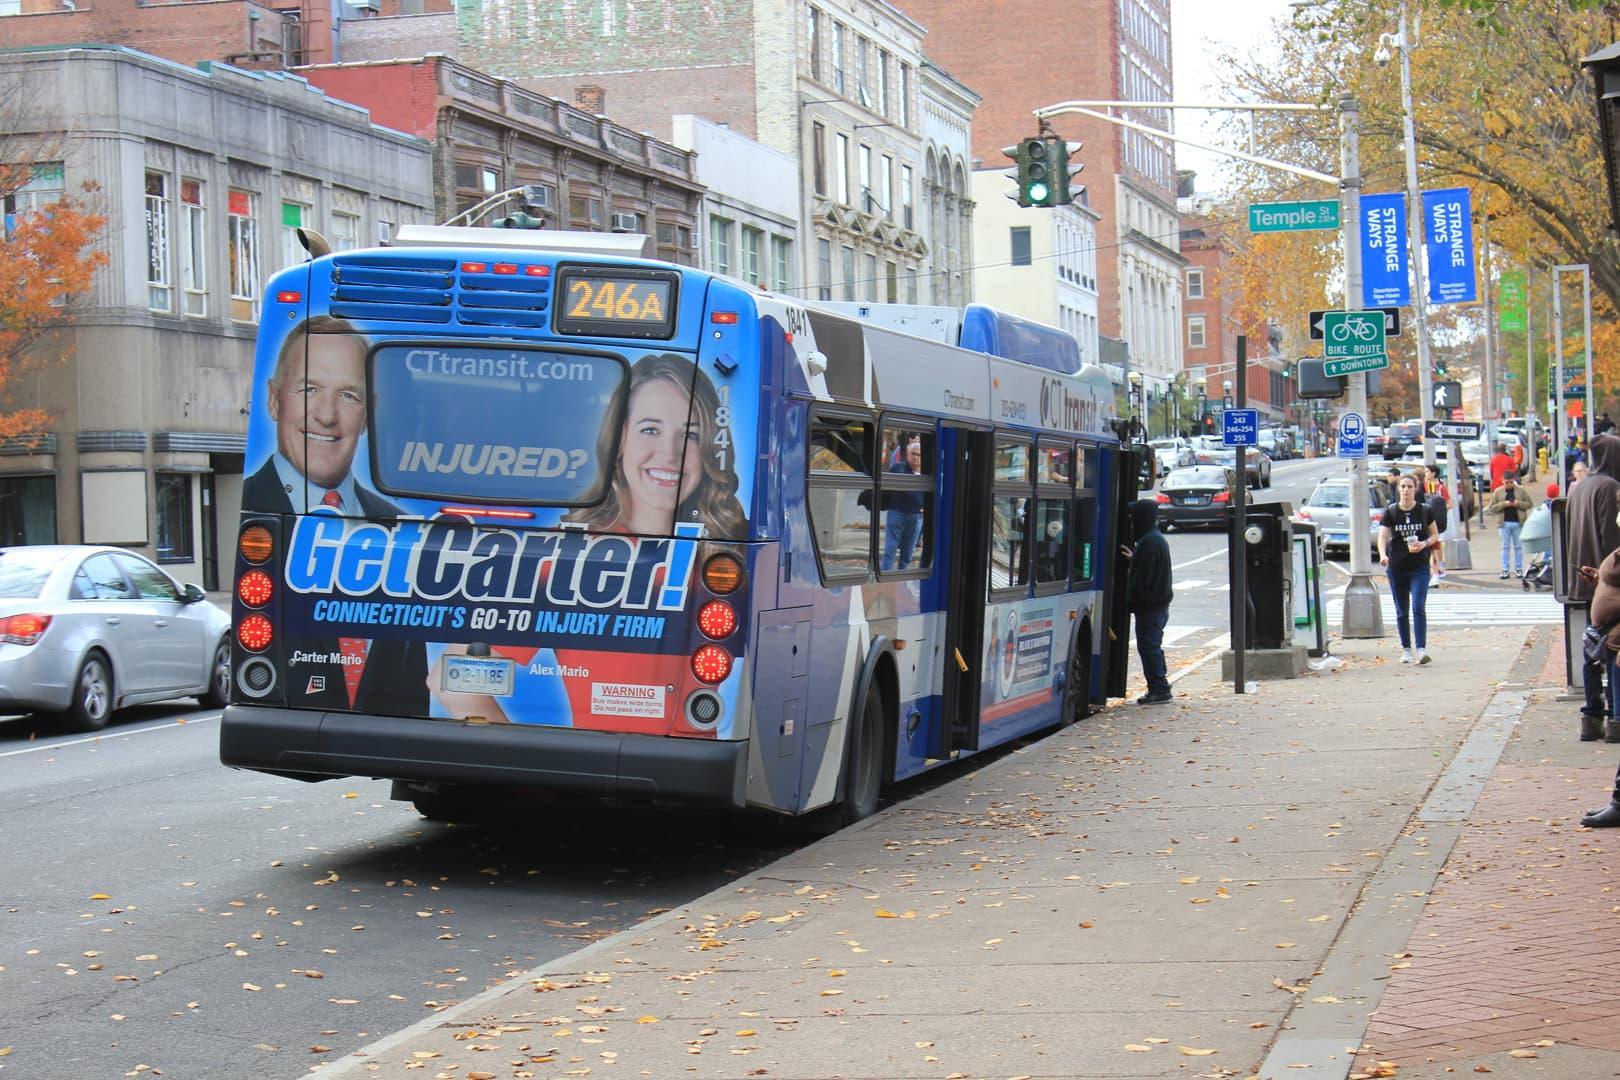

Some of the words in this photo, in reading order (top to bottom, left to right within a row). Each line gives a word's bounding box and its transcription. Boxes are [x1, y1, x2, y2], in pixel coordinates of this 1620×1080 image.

[1252, 207, 1316, 228] Temple
[1320, 206, 1330, 216] St
[1367, 209, 1383, 249] WAYS
[1432, 204, 1448, 244] WAYS
[1383, 207, 1399, 273] STRANGE
[1448, 202, 1465, 268] STRANGE
[569, 280, 664, 321] 246A
[786, 306, 807, 336] 1841
[1328, 345, 1348, 355] BIKE
[1354, 344, 1382, 354] ROUTE
[1341, 357, 1383, 371] DOWNTOWN
[405, 350, 594, 382] CTtransit.com
[714, 385, 732, 471] 1841
[398, 441, 589, 479] INJURED?
[1395, 523, 1422, 531] AGAINST
[313, 600, 467, 629] CONNECTICUT'S
[470, 608, 532, 631] GO-TO
[535, 611, 608, 634] INJURY
[612, 616, 665, 639] FIRM
[294, 650, 328, 664] Carter
[330, 652, 362, 665] Mario
[529, 662, 553, 677] Alex
[555, 664, 589, 679] Mario
[602, 685, 656, 698] WARNING
